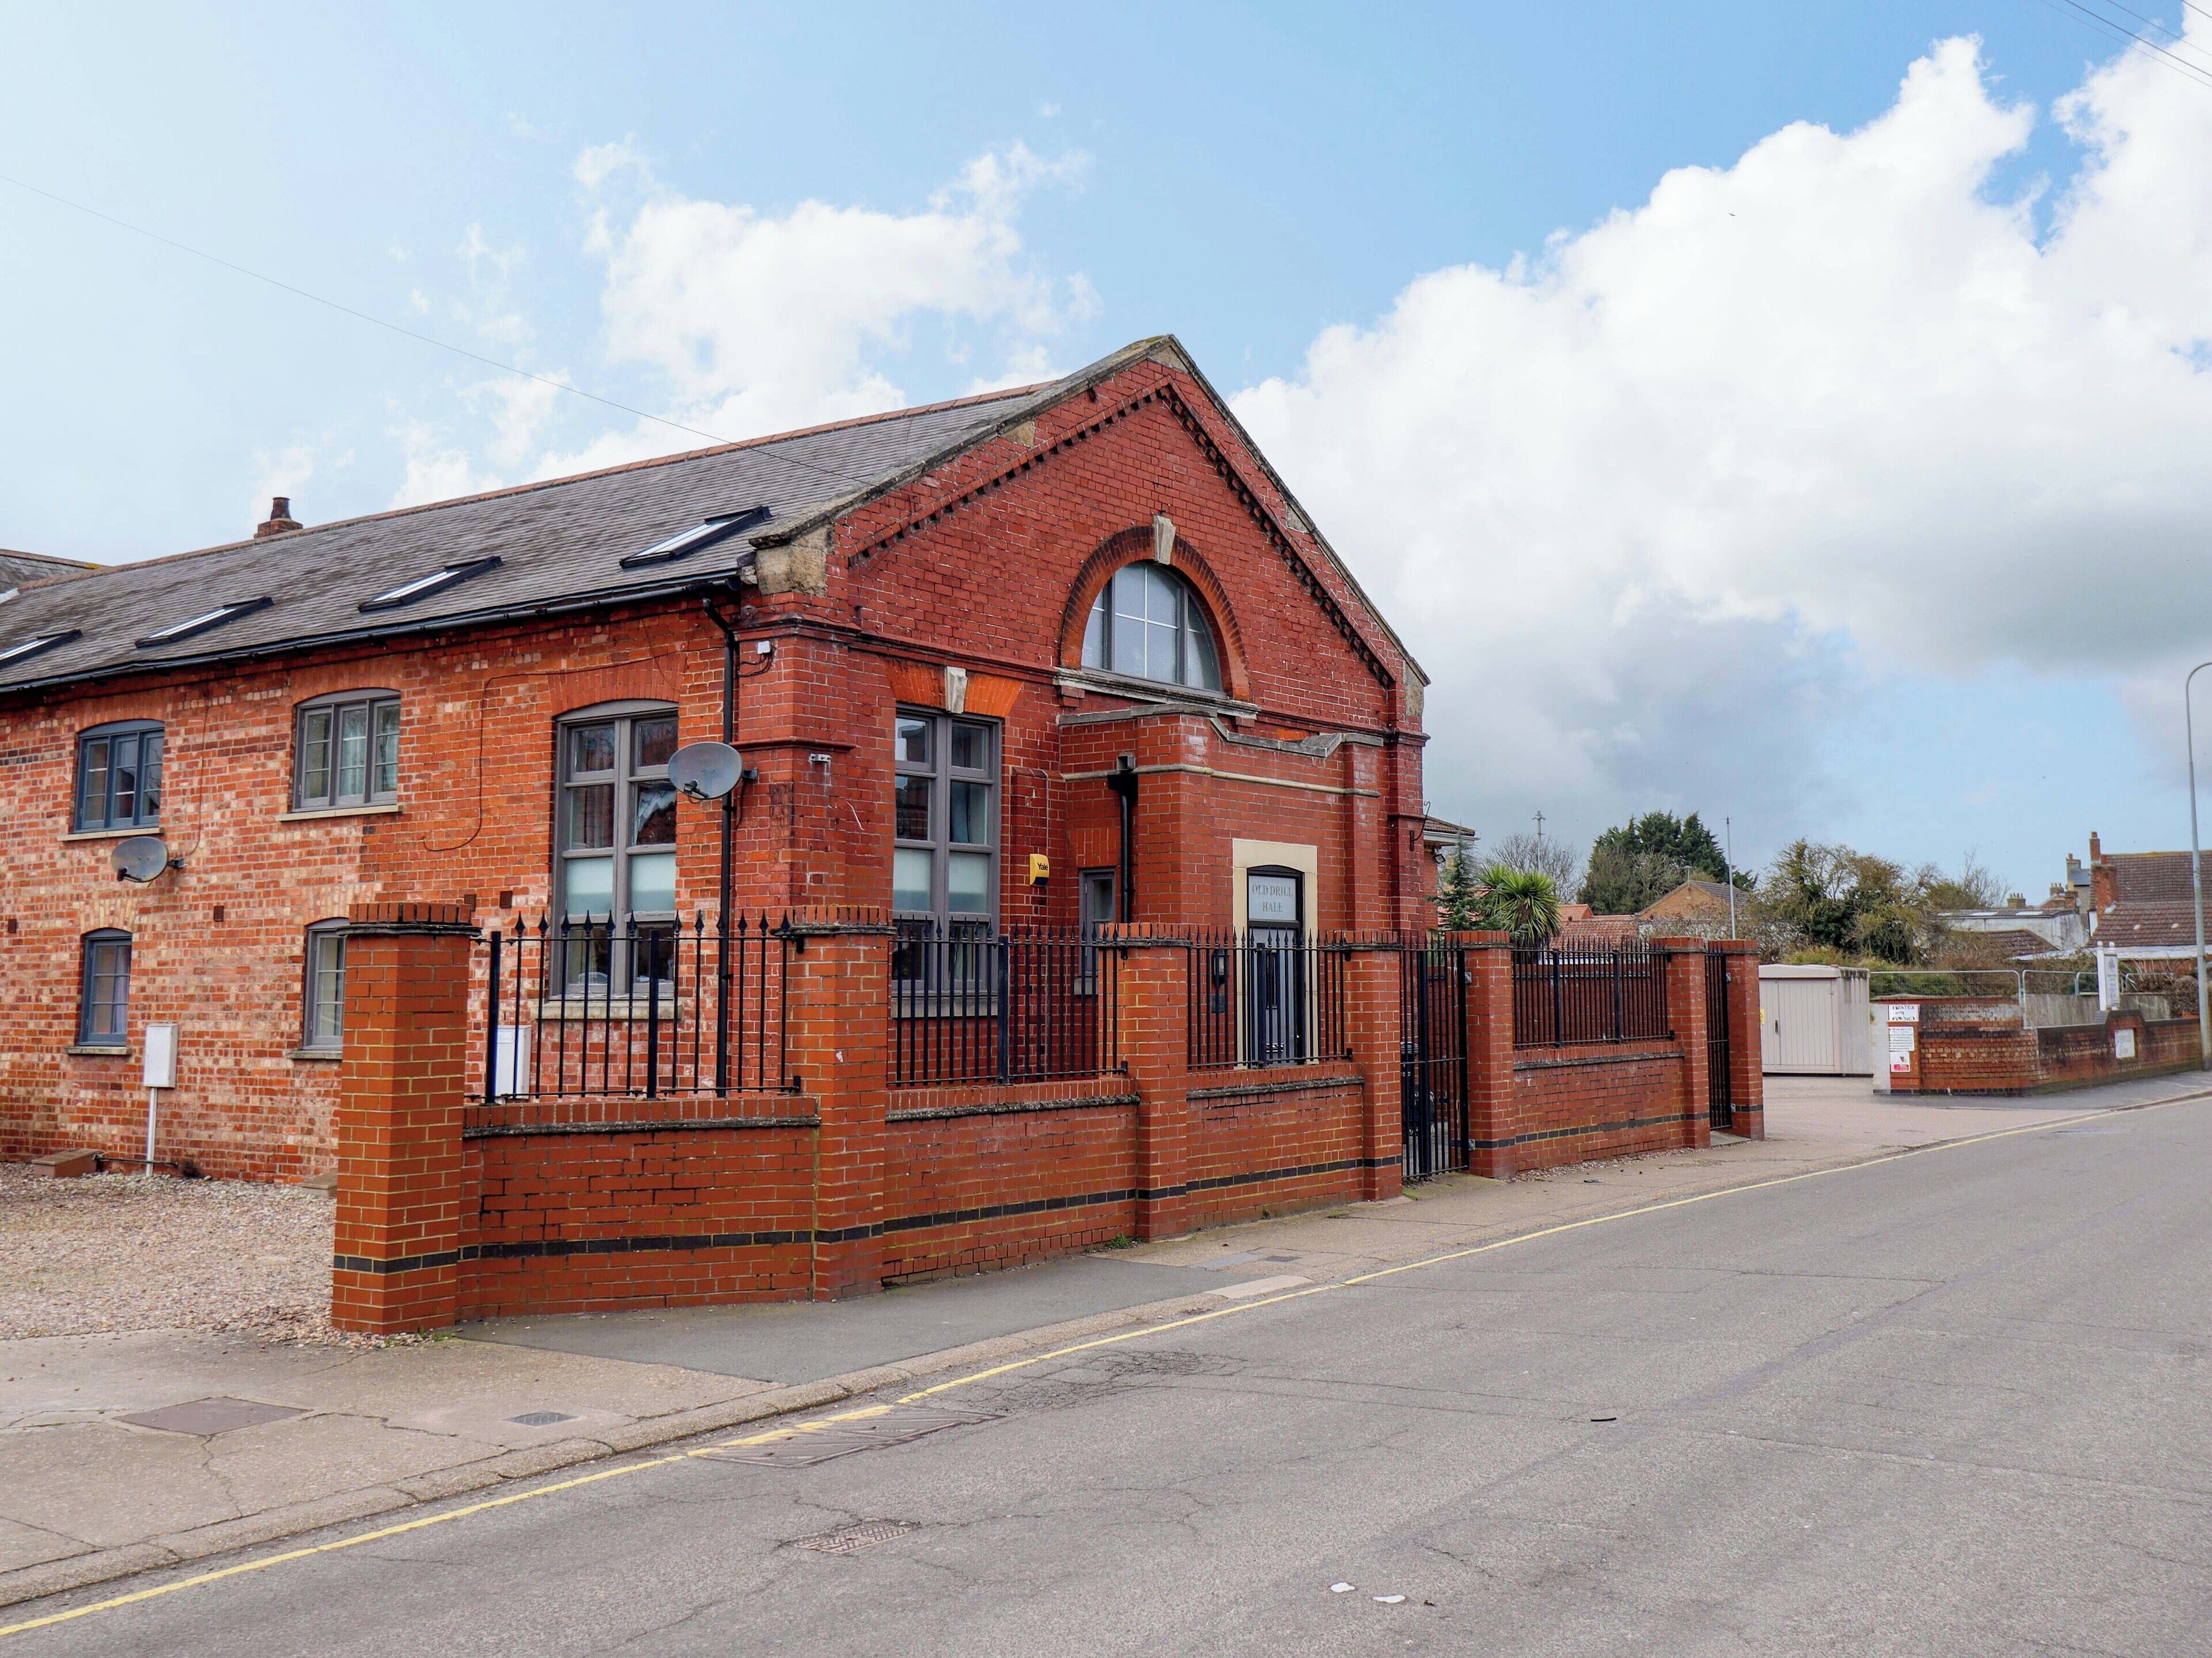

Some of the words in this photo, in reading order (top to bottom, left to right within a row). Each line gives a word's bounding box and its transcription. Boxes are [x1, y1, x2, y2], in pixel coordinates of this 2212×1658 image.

[1037, 863, 1048, 871] Yale
[1252, 884, 1268, 896] OLD
[1270, 886, 1293, 897] DRILL
[1262, 901, 1283, 912] HALL
